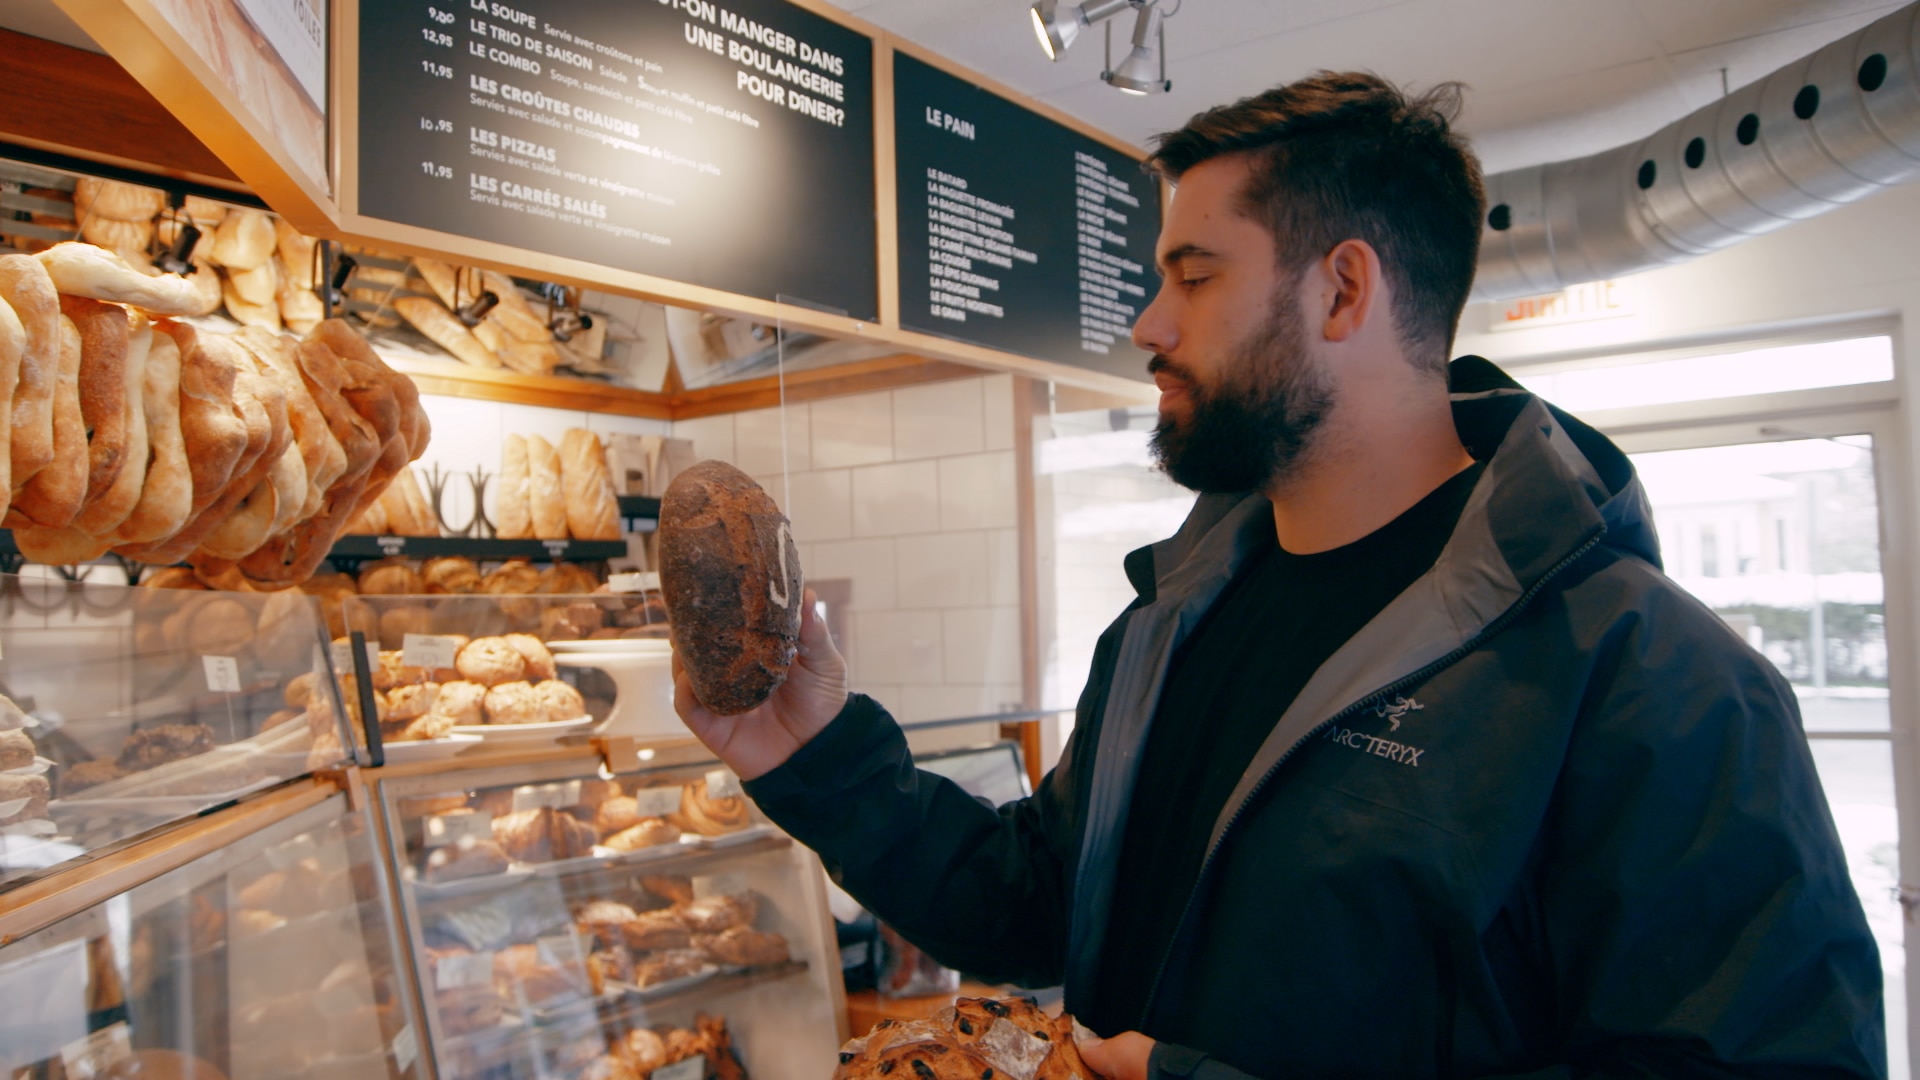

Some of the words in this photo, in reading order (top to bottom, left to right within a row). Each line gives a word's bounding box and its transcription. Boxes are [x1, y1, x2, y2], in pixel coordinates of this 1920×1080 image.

[422, 28, 453, 48] 12,95
[470, 0, 488, 13] LA
[491, 2, 536, 30] SOUPE
[544, 23, 572, 42] Servie
[574, 36, 595, 50] avec
[596, 43, 633, 64] croûtons
[634, 57, 644, 68] et
[645, 61, 662, 75] pain
[720, 9, 796, 56] MANGER
[800, 42, 844, 76] DANS
[470, 18, 487, 36] LE
[489, 24, 522, 46] TRIO
[524, 36, 542, 54] DE
[546, 44, 593, 71] SAISON
[600, 64, 628, 83] Salade
[422, 60, 453, 79] 11,95
[470, 41, 486, 58] LE
[489, 48, 541, 75] COMBO
[583, 82, 622, 101] sandwich
[685, 22, 724, 55] UNE
[728, 40, 844, 102] BOULANGERIE
[470, 74, 498, 95] LES
[501, 84, 570, 117] CROÛTES
[573, 106, 640, 139] CHAUDES
[737, 70, 785, 106] POUR
[788, 90, 844, 127] DÎNER?
[470, 92, 506, 113] Servies
[507, 106, 530, 120] avec
[531, 113, 561, 129] salade
[563, 122, 573, 133] et
[926, 106, 942, 128] LE
[944, 113, 975, 140] PAIN
[470, 127, 498, 148] LES
[501, 135, 556, 162] PIZZAS
[422, 161, 453, 179] 11,95
[470, 143, 506, 163] Servies
[507, 156, 530, 169] avec
[532, 162, 561, 178] salade
[563, 170, 587, 184] verte
[588, 176, 599, 188] et
[927, 167, 938, 180] LE
[470, 172, 498, 193] LES
[500, 181, 560, 208] CARRÉS
[563, 196, 608, 220] SALÉS
[928, 181, 938, 194] LA
[470, 189, 500, 206] Servis
[502, 201, 524, 213] avec
[526, 206, 556, 220] salade
[558, 212, 582, 225] verte
[583, 219, 593, 228] et
[928, 194, 939, 206] LA
[928, 208, 939, 220] LA
[928, 222, 940, 233] LA
[929, 235, 939, 248] LE
[930, 248, 940, 261] LA
[930, 262, 944, 276] LES
[930, 276, 941, 288] LA
[930, 290, 940, 302] LE
[931, 304, 941, 316] LE
